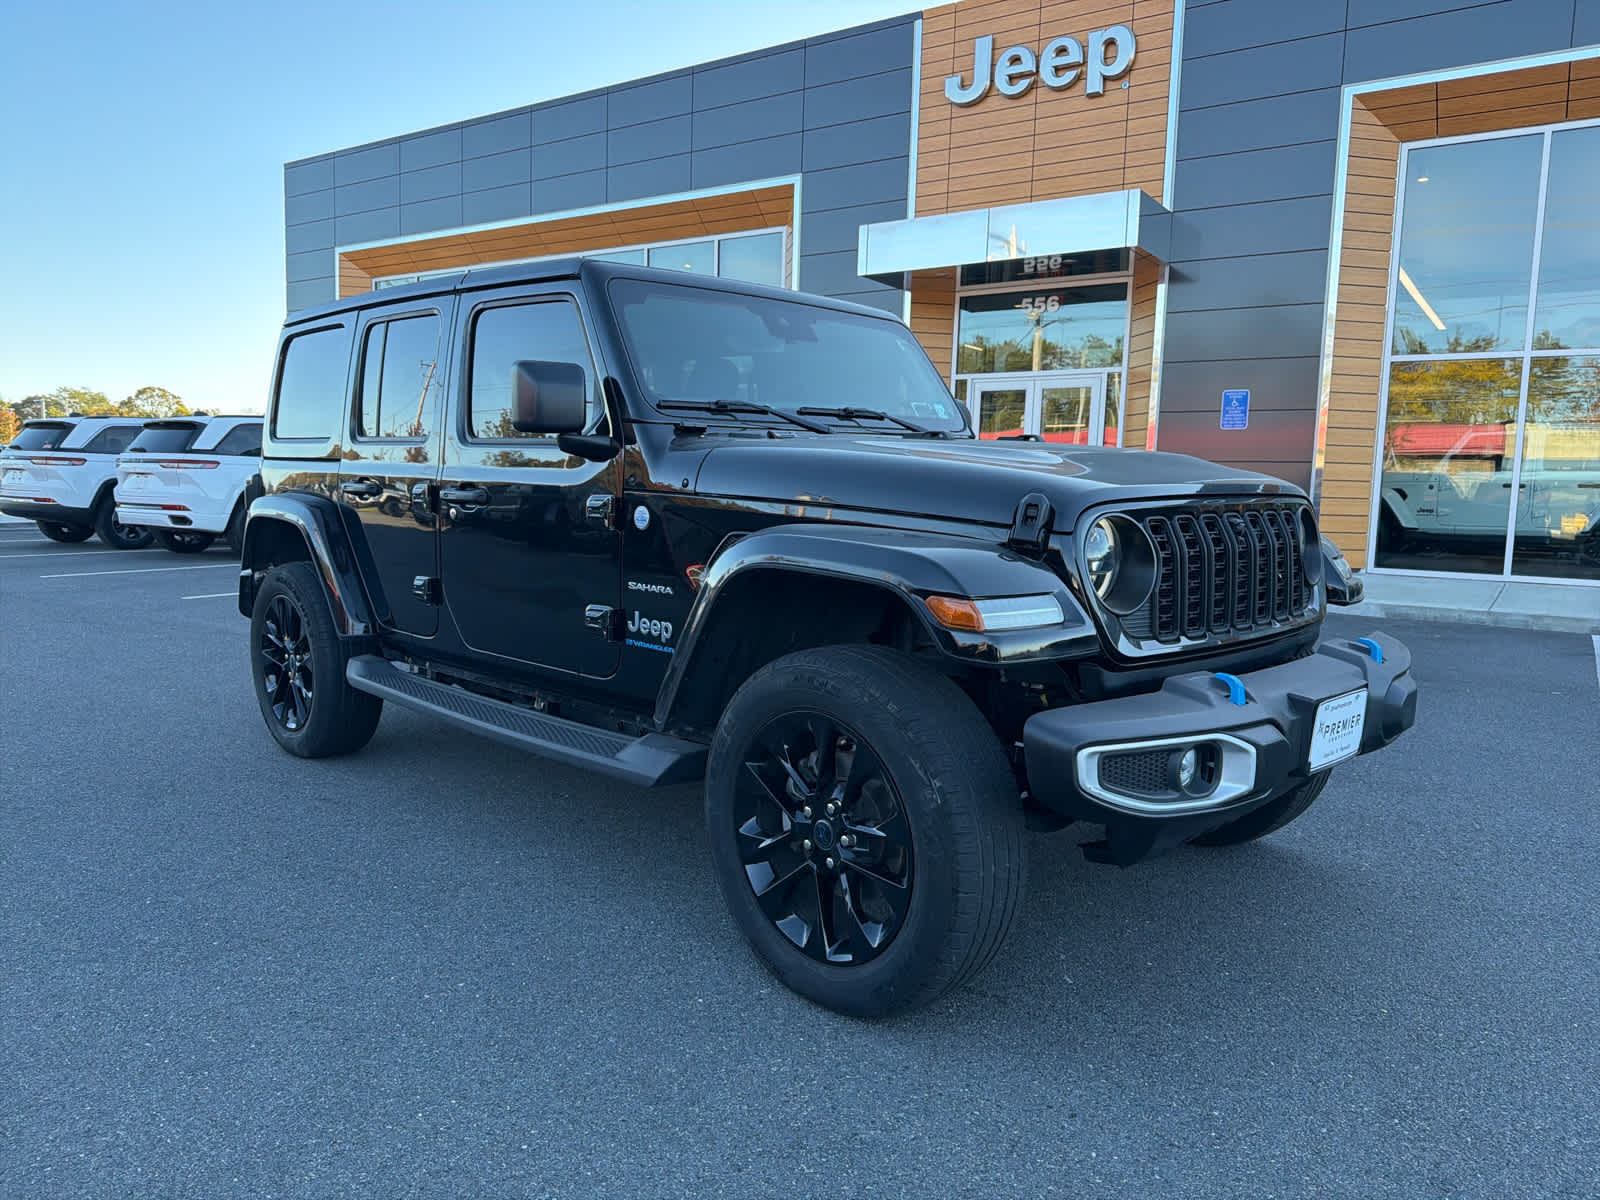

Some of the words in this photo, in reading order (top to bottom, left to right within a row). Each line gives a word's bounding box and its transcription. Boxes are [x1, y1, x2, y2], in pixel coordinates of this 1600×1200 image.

[944, 24, 1136, 107] Jeep
[1021, 295, 1060, 313] 556
[627, 581, 673, 595] SAHARA
[627, 610, 673, 643] Jeep
[1324, 713, 1361, 737] PREMIER
